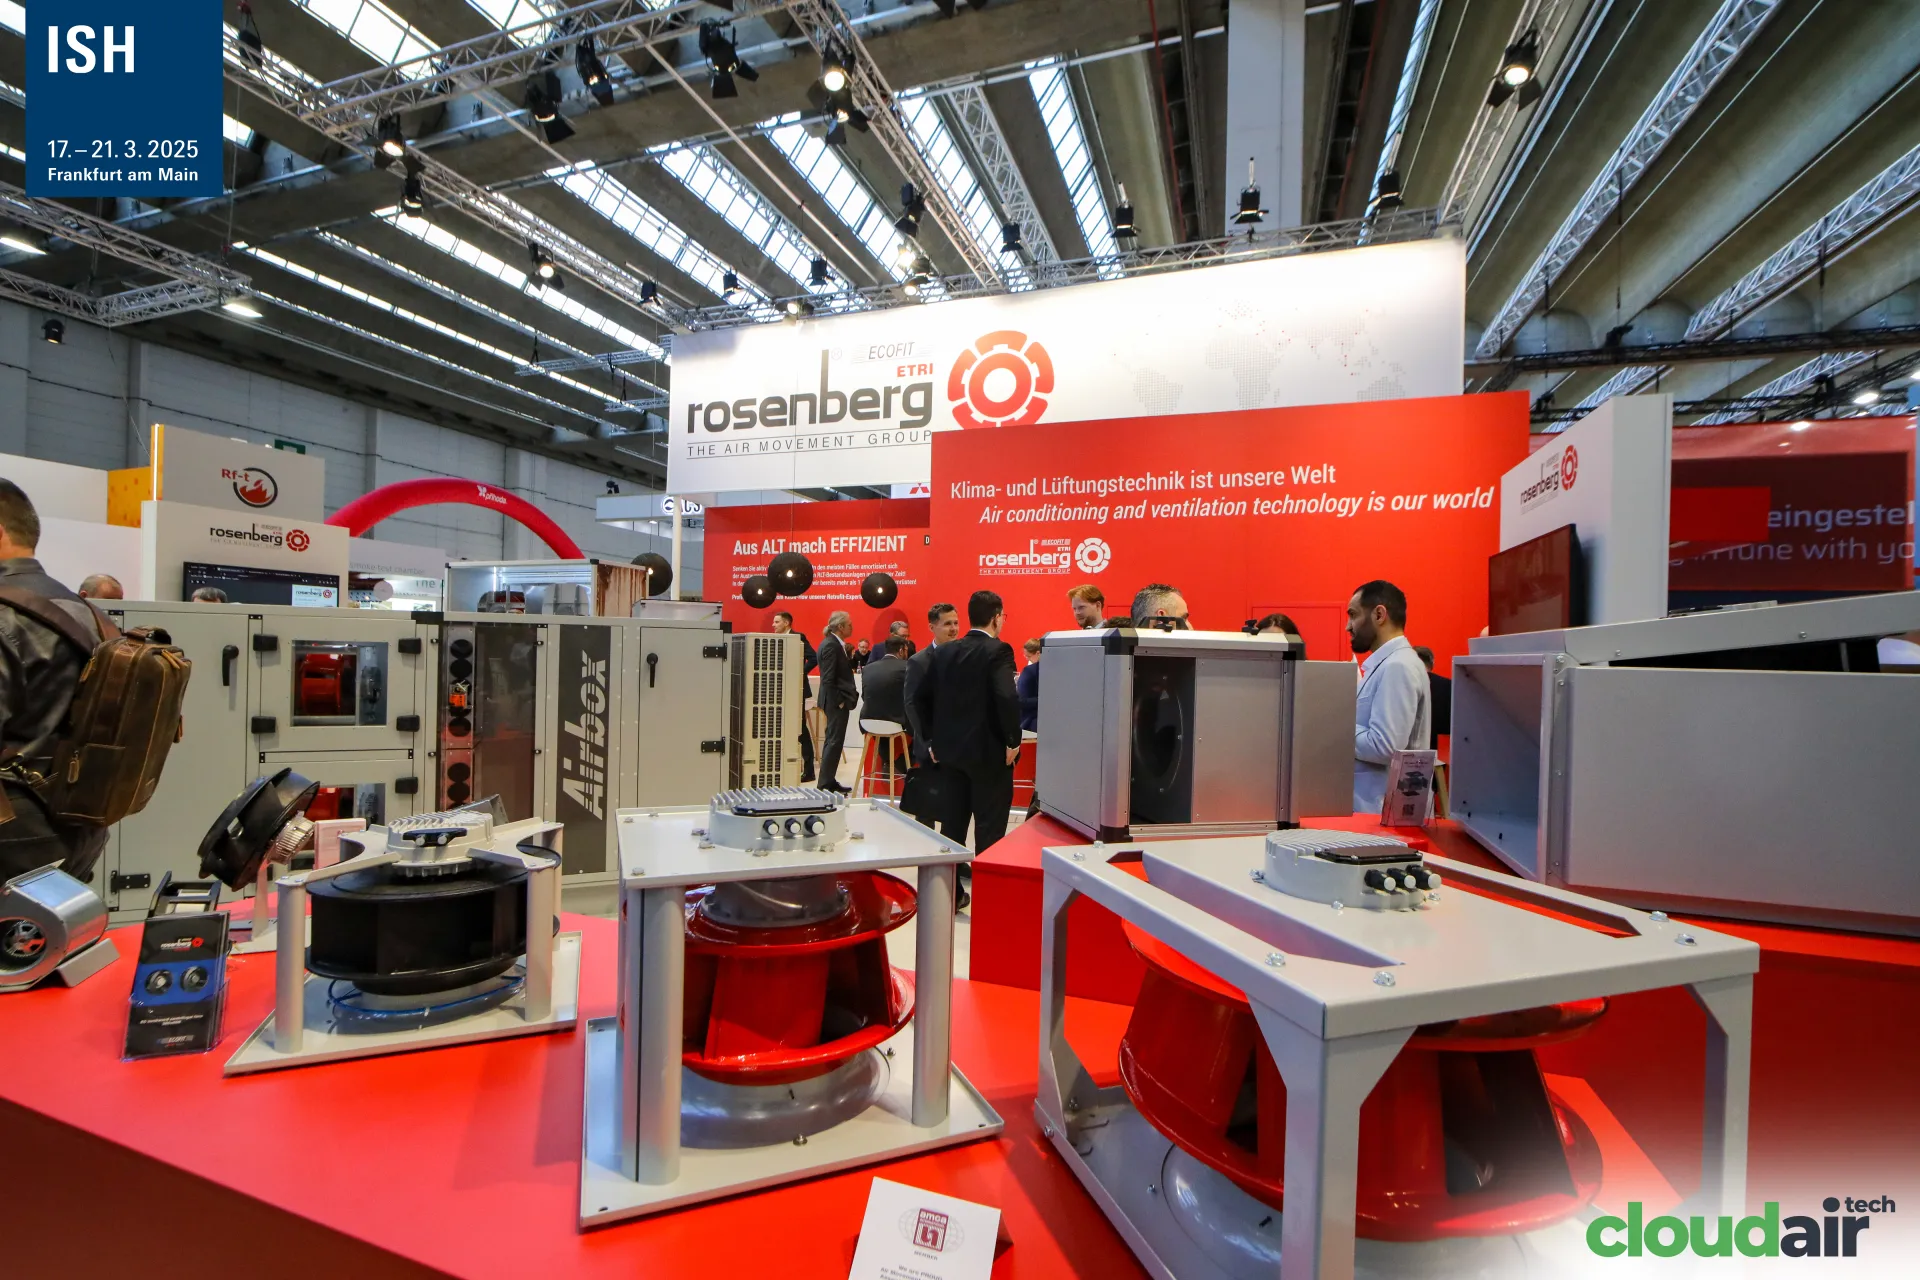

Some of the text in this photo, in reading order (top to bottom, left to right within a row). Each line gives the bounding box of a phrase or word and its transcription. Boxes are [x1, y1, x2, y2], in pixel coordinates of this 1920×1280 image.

[868, 341, 916, 360] ECOFIT
[896, 363, 934, 378] ETRI
[687, 349, 934, 434] rosenberg
[687, 429, 933, 458] THE AIR MOVEMENT GROUP
[951, 463, 1336, 499] Klima- und Lüftungstechnik ist unsere Welt
[979, 505, 1004, 524] Air
[1006, 502, 1110, 525] conditioning
[1113, 500, 1147, 520] and
[1151, 497, 1247, 518] ventilation
[1253, 493, 1363, 518] technology
[1367, 490, 1386, 512] is
[1391, 493, 1428, 511] our
[1432, 486, 1496, 510] world
[210, 523, 283, 547] rosenberg
[733, 534, 908, 556] Aus ALT mach EFFIZIENT
[979, 539, 1071, 568] rosenberg
[1801, 537, 1867, 560] with
[562, 649, 607, 822] Airbox
[920, 1210, 948, 1224] amca
